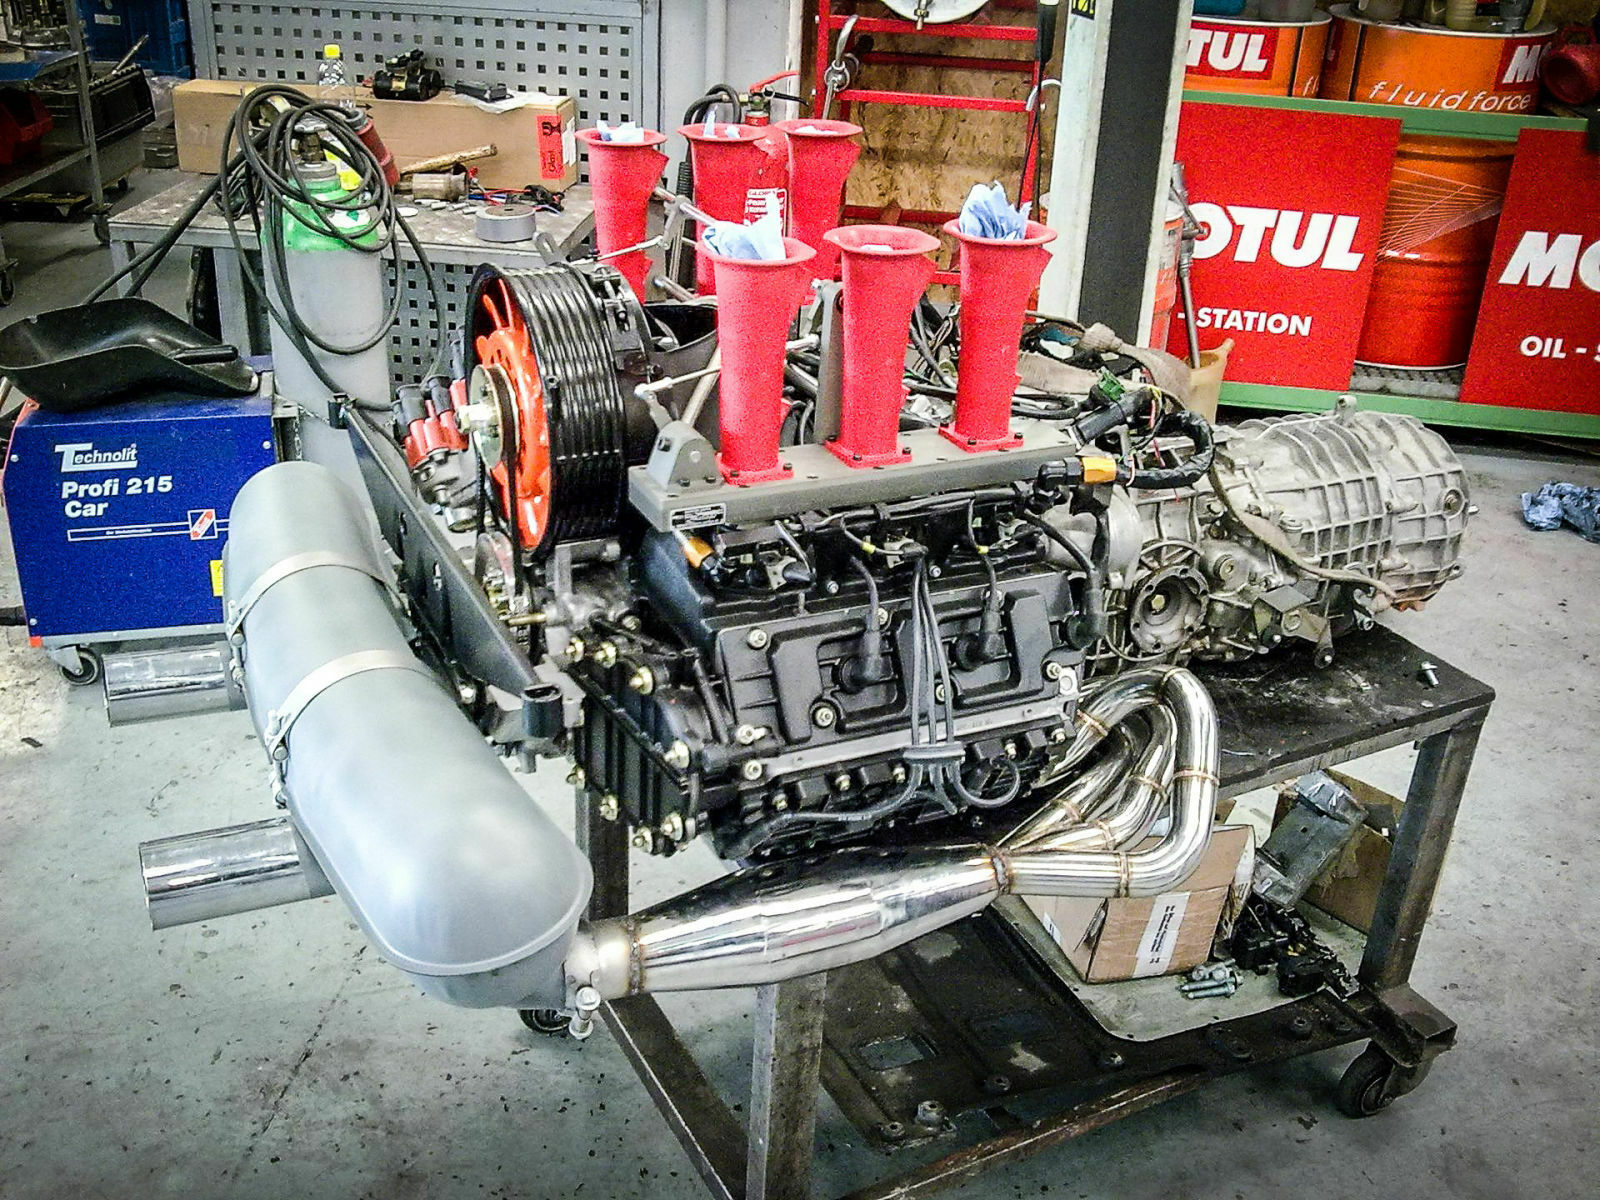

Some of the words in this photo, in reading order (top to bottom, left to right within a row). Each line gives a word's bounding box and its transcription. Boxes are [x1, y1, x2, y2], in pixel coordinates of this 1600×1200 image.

[1501, 42, 1551, 84] M
[1369, 81, 1469, 110] fluid
[1467, 91, 1531, 112] force
[1196, 307, 1312, 337] STATION
[1520, 336, 1566, 359] OIL
[54, 442, 138, 473] Technolit
[61, 478, 119, 499] Profi
[126, 475, 173, 495] 215
[64, 500, 109, 518] Car
